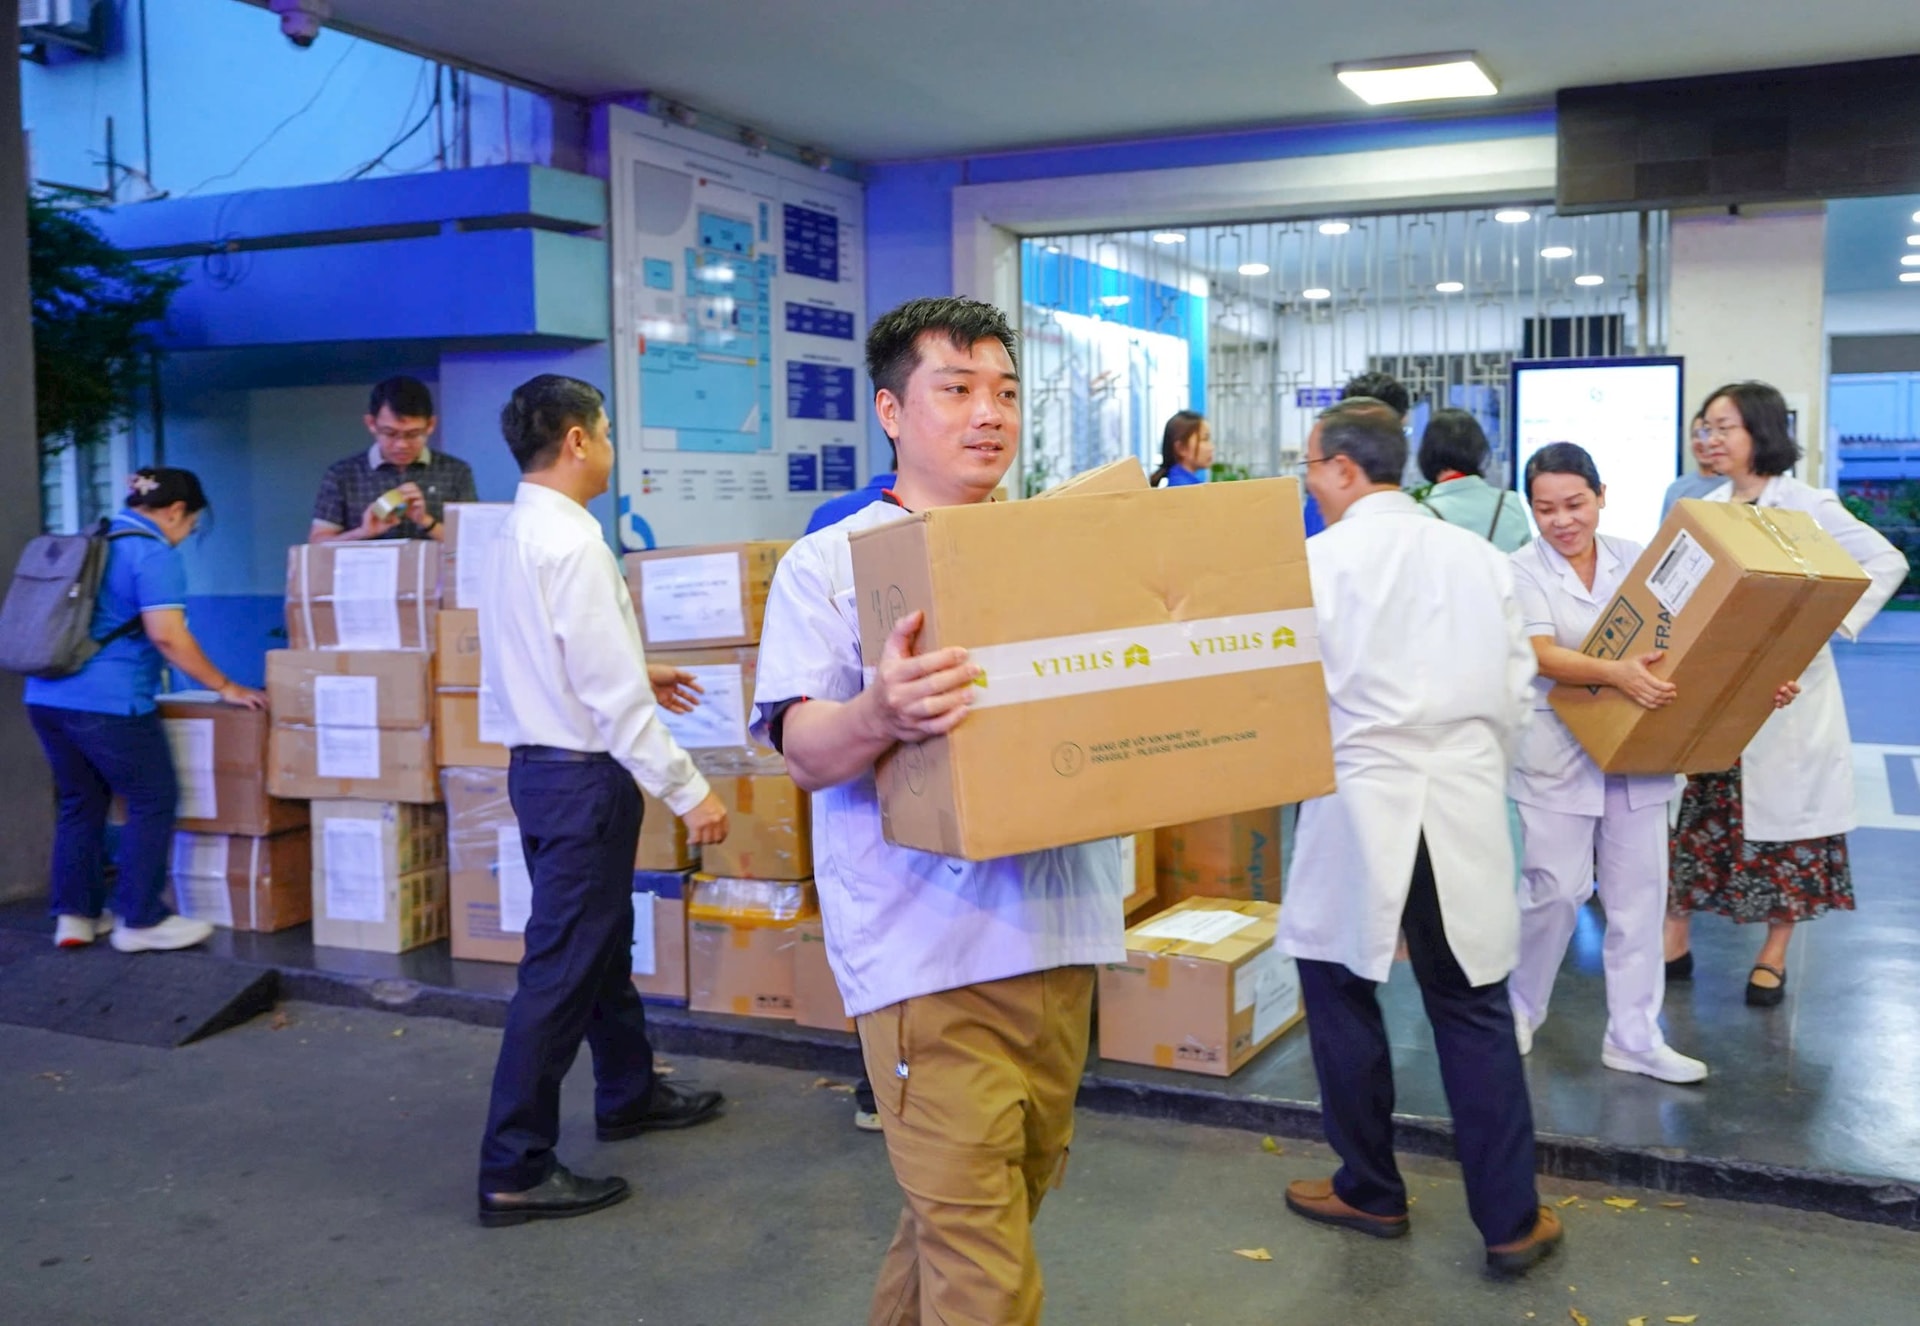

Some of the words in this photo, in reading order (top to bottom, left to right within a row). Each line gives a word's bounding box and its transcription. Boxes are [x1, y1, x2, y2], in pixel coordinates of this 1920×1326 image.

[1655, 601, 1672, 650] FRA
[1189, 632, 1263, 655] STELLA
[1032, 651, 1113, 677] STELLA
